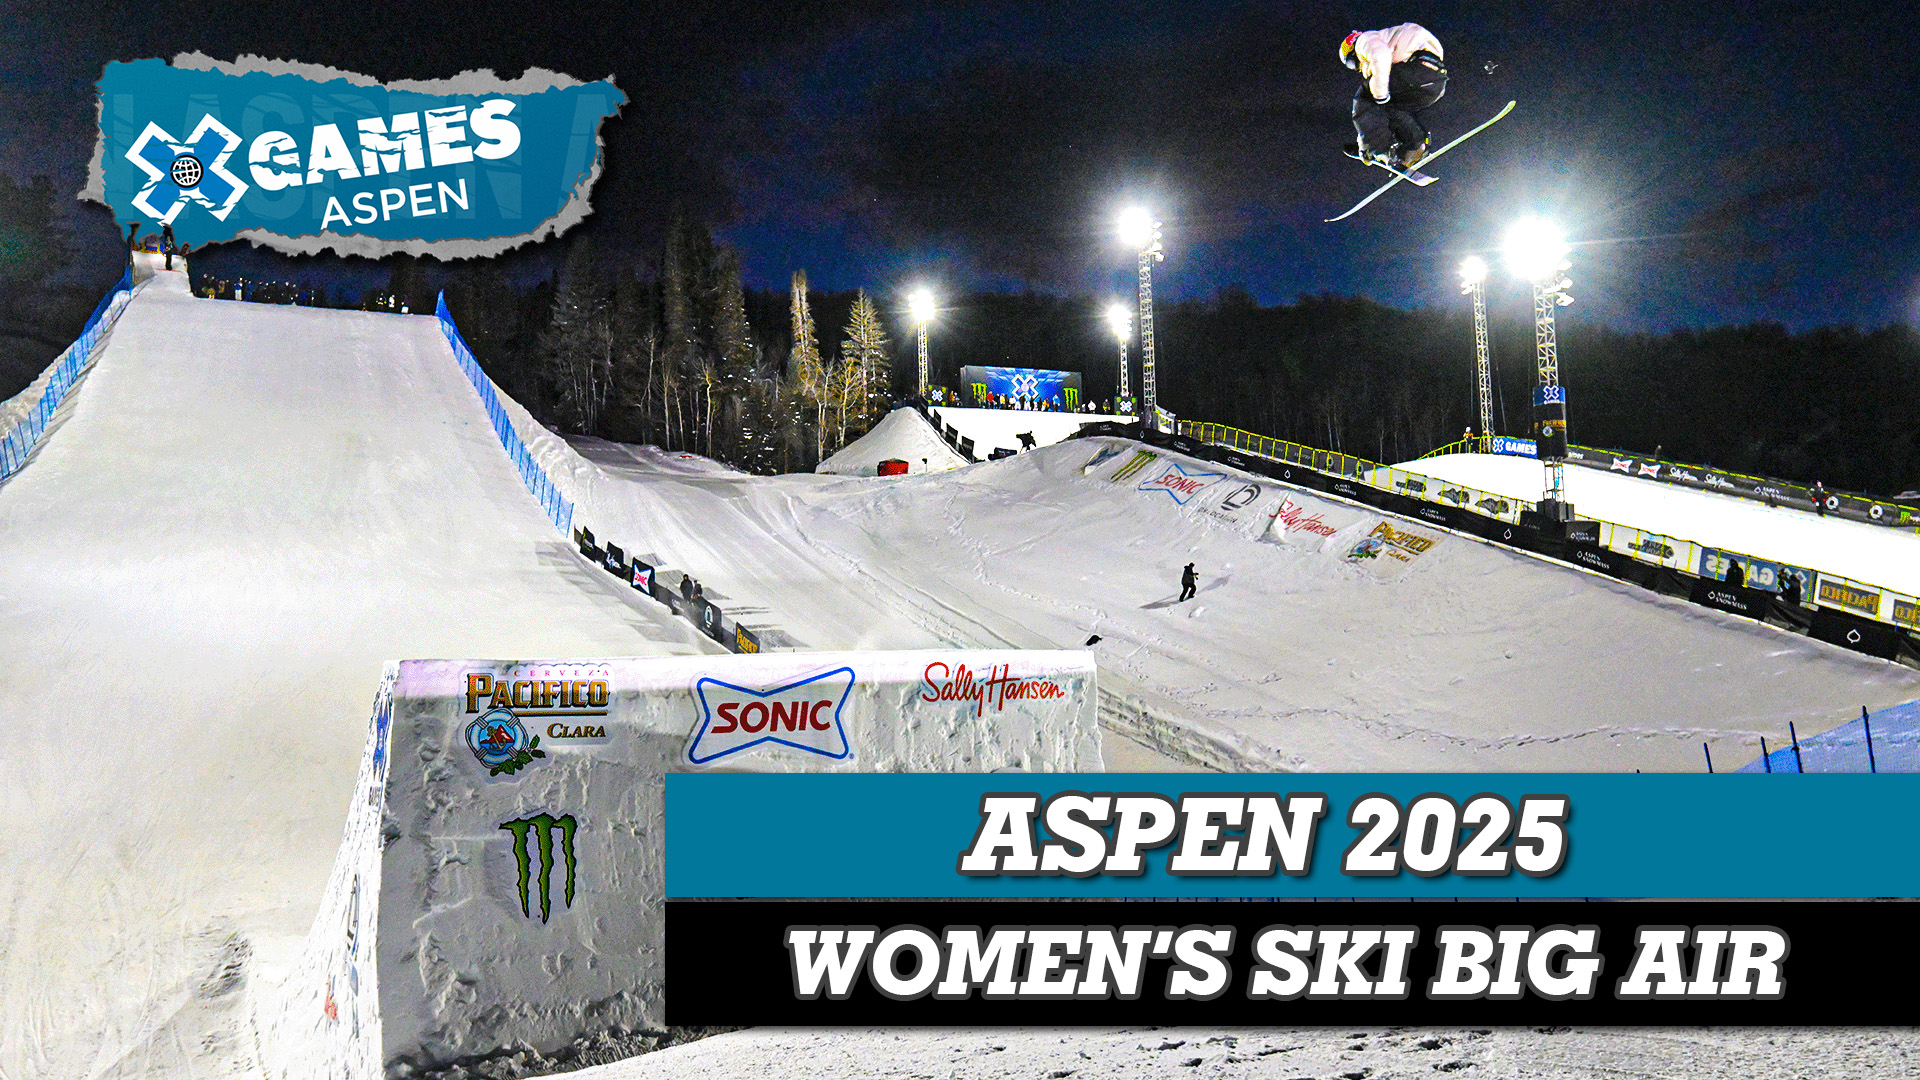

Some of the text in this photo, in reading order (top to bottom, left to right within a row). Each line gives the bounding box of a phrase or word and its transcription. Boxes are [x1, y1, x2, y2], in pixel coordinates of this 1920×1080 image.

[1505, 441, 1537, 455] GAMES
[1155, 473, 1206, 494] SONIC
[1367, 520, 1435, 553] PACIFICO
[1716, 591, 1737, 601] ASPEN
[514, 669, 609, 677] CERVEZA
[465, 672, 611, 714] PACIFICO
[922, 661, 1065, 717] Sally Hansen
[711, 699, 833, 734] SONIC
[546, 722, 606, 739] CLARA
